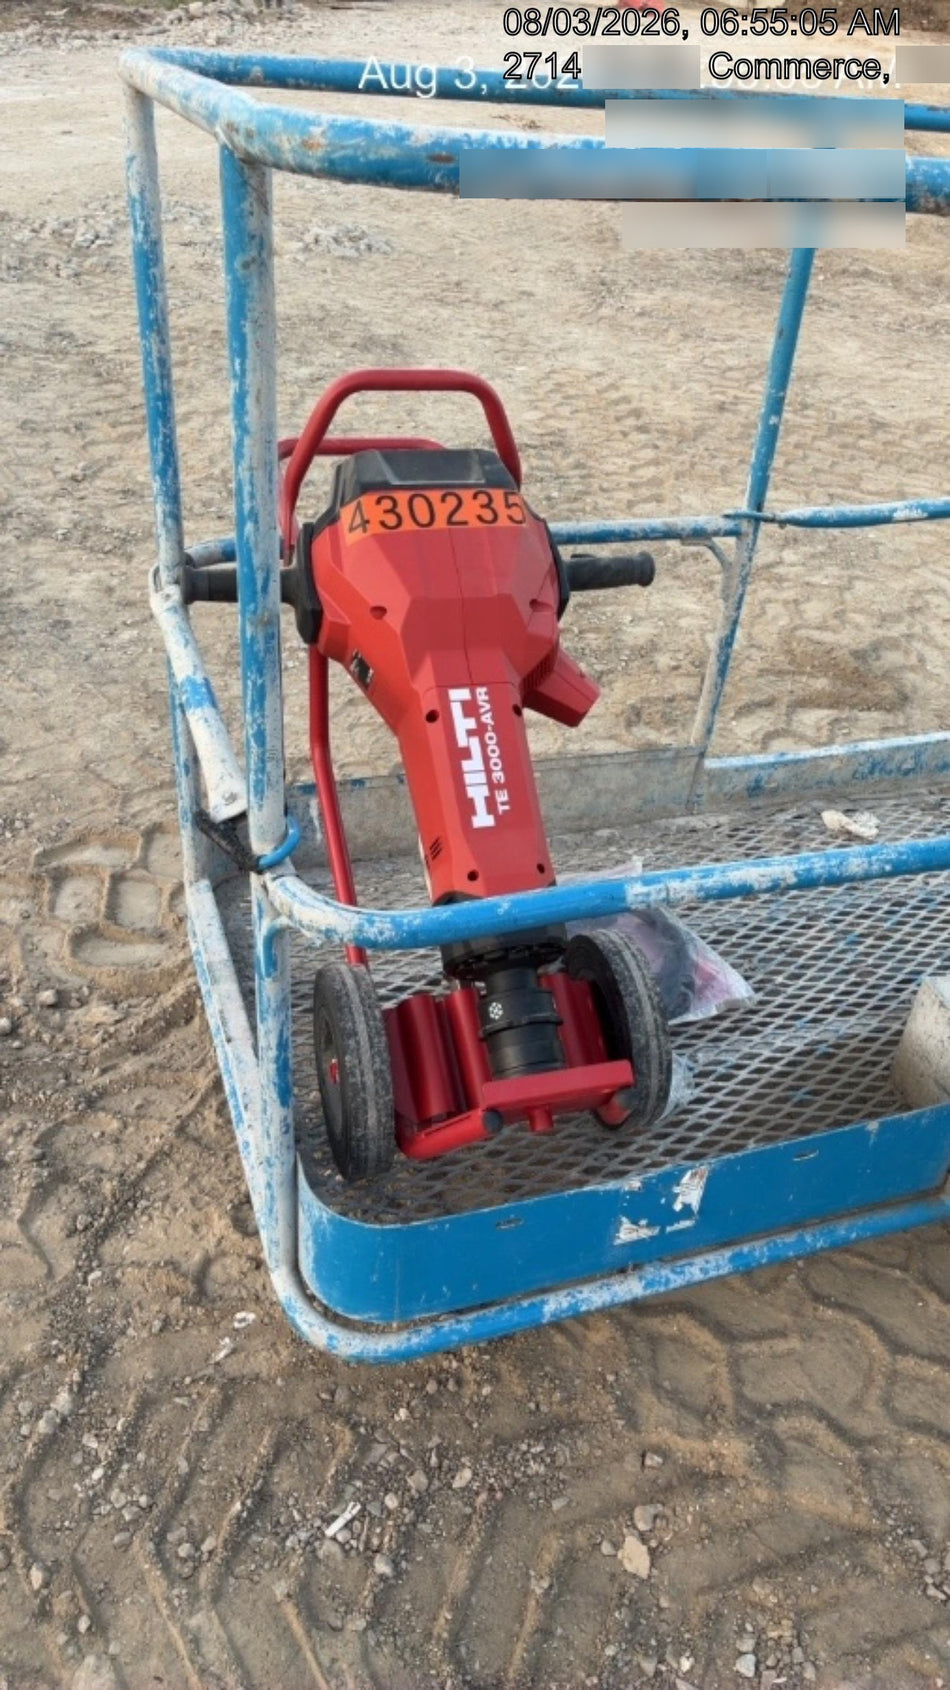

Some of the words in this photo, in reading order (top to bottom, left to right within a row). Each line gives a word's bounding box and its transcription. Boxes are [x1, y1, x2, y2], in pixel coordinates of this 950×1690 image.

[348, 489, 527, 534] 430235
[448, 687, 495, 829] HILTI
[476, 686, 505, 784] 3000-AVR
[495, 788, 511, 815] TE
